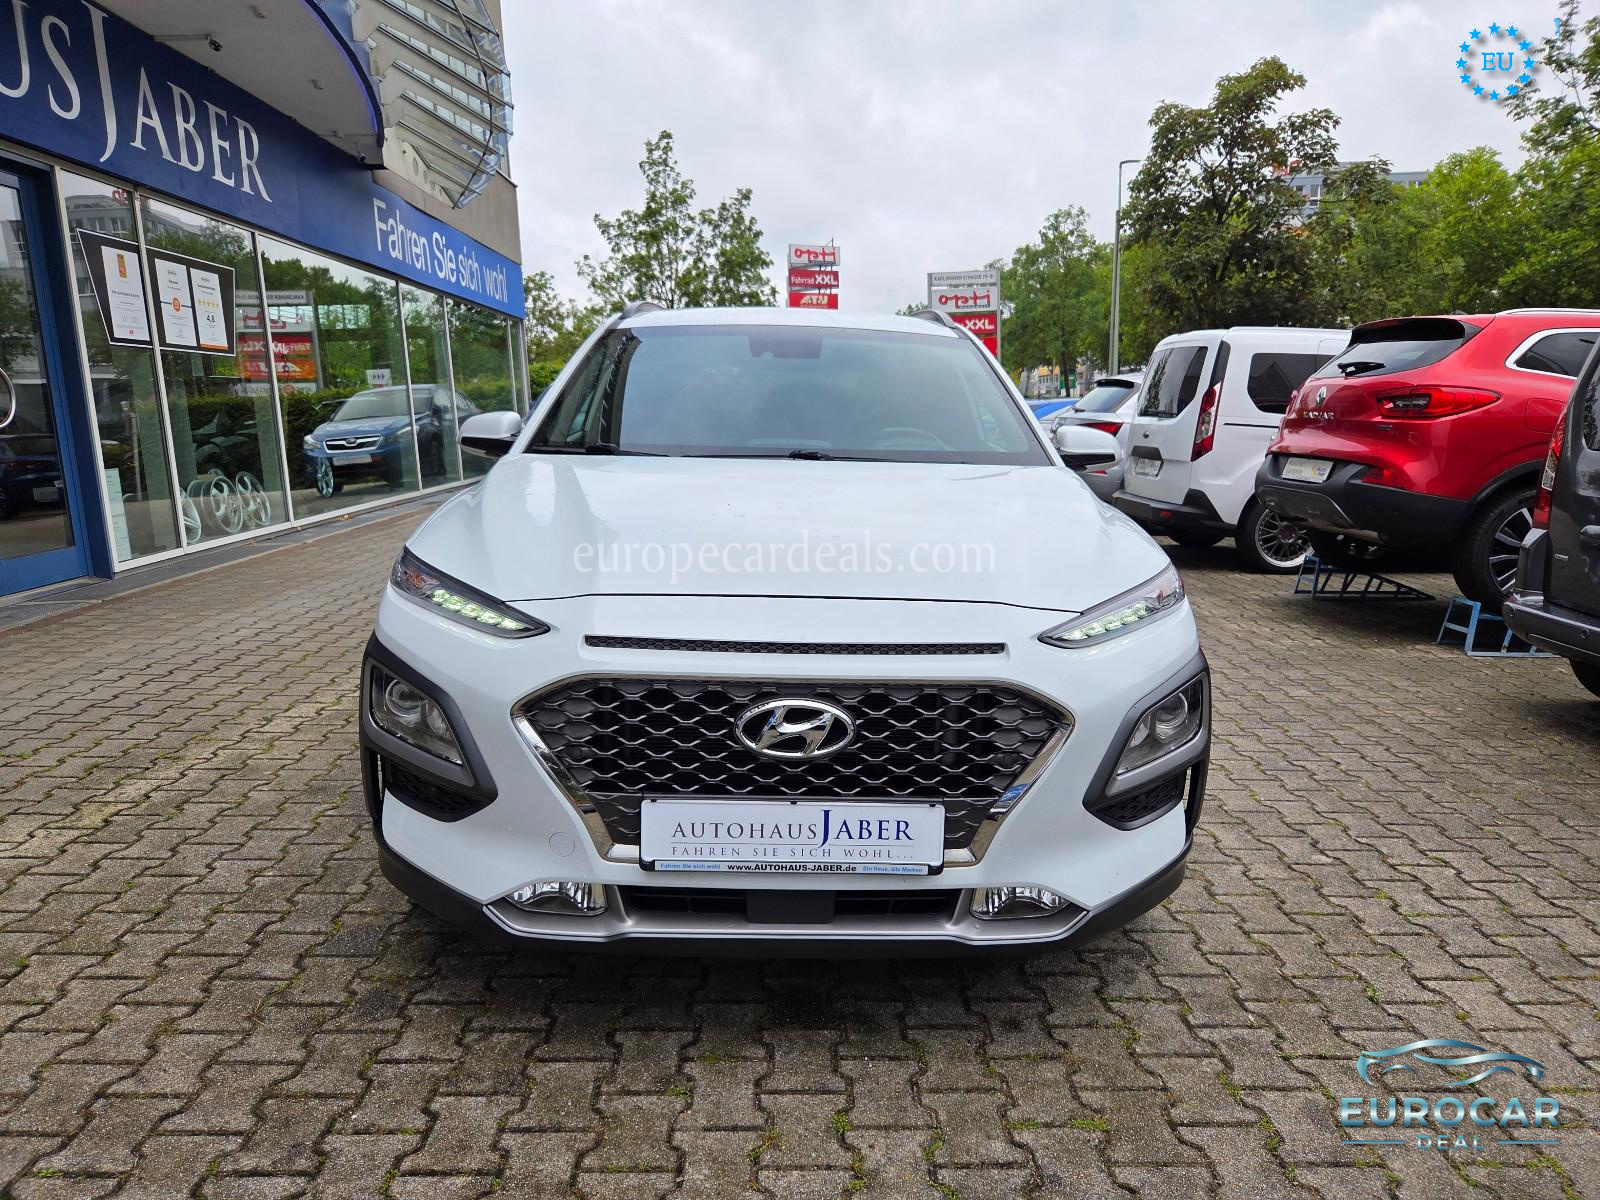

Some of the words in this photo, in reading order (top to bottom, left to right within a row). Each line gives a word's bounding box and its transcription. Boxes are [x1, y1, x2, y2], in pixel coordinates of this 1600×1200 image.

[373, 197, 432, 274] Fahren
[432, 231, 457, 284] Sie
[458, 246, 482, 294] sich
[483, 264, 508, 304] wohl
[791, 276, 815, 285] Fahrrad
[815, 274, 838, 285] XXL
[965, 318, 995, 330] XXL
[671, 846, 741, 857] FAHREN
[753, 847, 779, 858] SIE
[791, 847, 832, 858] SICH
[727, 863, 857, 873] www.AUTOHAUS-JABER.de
